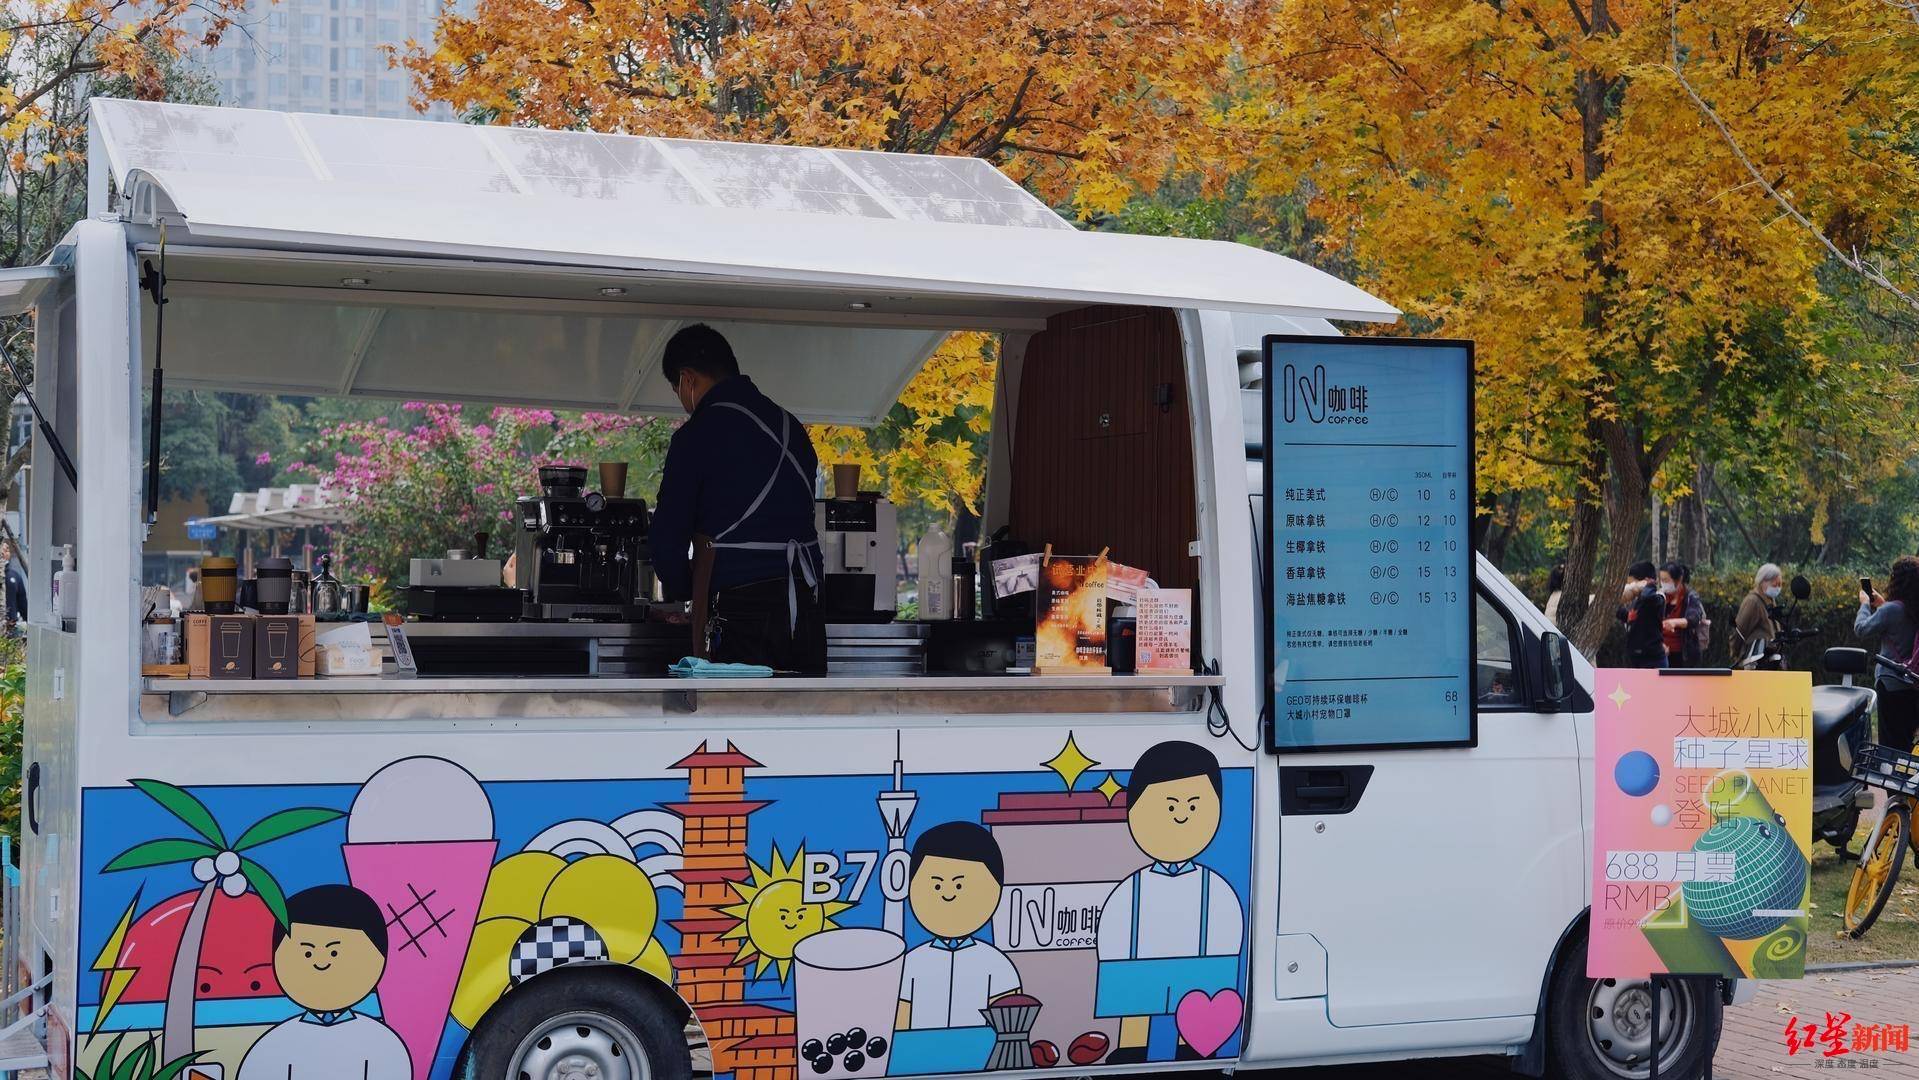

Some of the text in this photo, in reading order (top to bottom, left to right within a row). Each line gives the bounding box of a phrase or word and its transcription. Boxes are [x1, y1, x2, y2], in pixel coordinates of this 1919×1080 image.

[1327, 415, 1369, 425] COFFEE
[1286, 487, 1327, 502] 纯正美式
[1417, 489, 1431, 501] 10
[1449, 489, 1457, 501] 8
[1285, 513, 1326, 528] 原味拿铁
[1417, 515, 1431, 527] 12
[1443, 515, 1457, 527] 10
[1285, 540, 1326, 554] 生椰拿铁
[1417, 540, 1431, 552] 12
[1443, 540, 1457, 552] 10
[1285, 566, 1326, 581] 香草拿铁
[1417, 566, 1431, 577] 15
[1443, 566, 1457, 577] 13
[1285, 592, 1346, 607] 海盐焦糖拿铁
[1417, 592, 1431, 603] 15
[1443, 592, 1457, 603] 13
[1445, 691, 1458, 702] 68
[1675, 705, 1809, 739] 大城小村
[1674, 739, 1809, 769] 种子星球
[1675, 775, 1809, 795] SEED PLANET
[1673, 799, 1739, 830] 登陆
[1605, 852, 1736, 882] 688 月票
[1604, 884, 1672, 911] RMB
